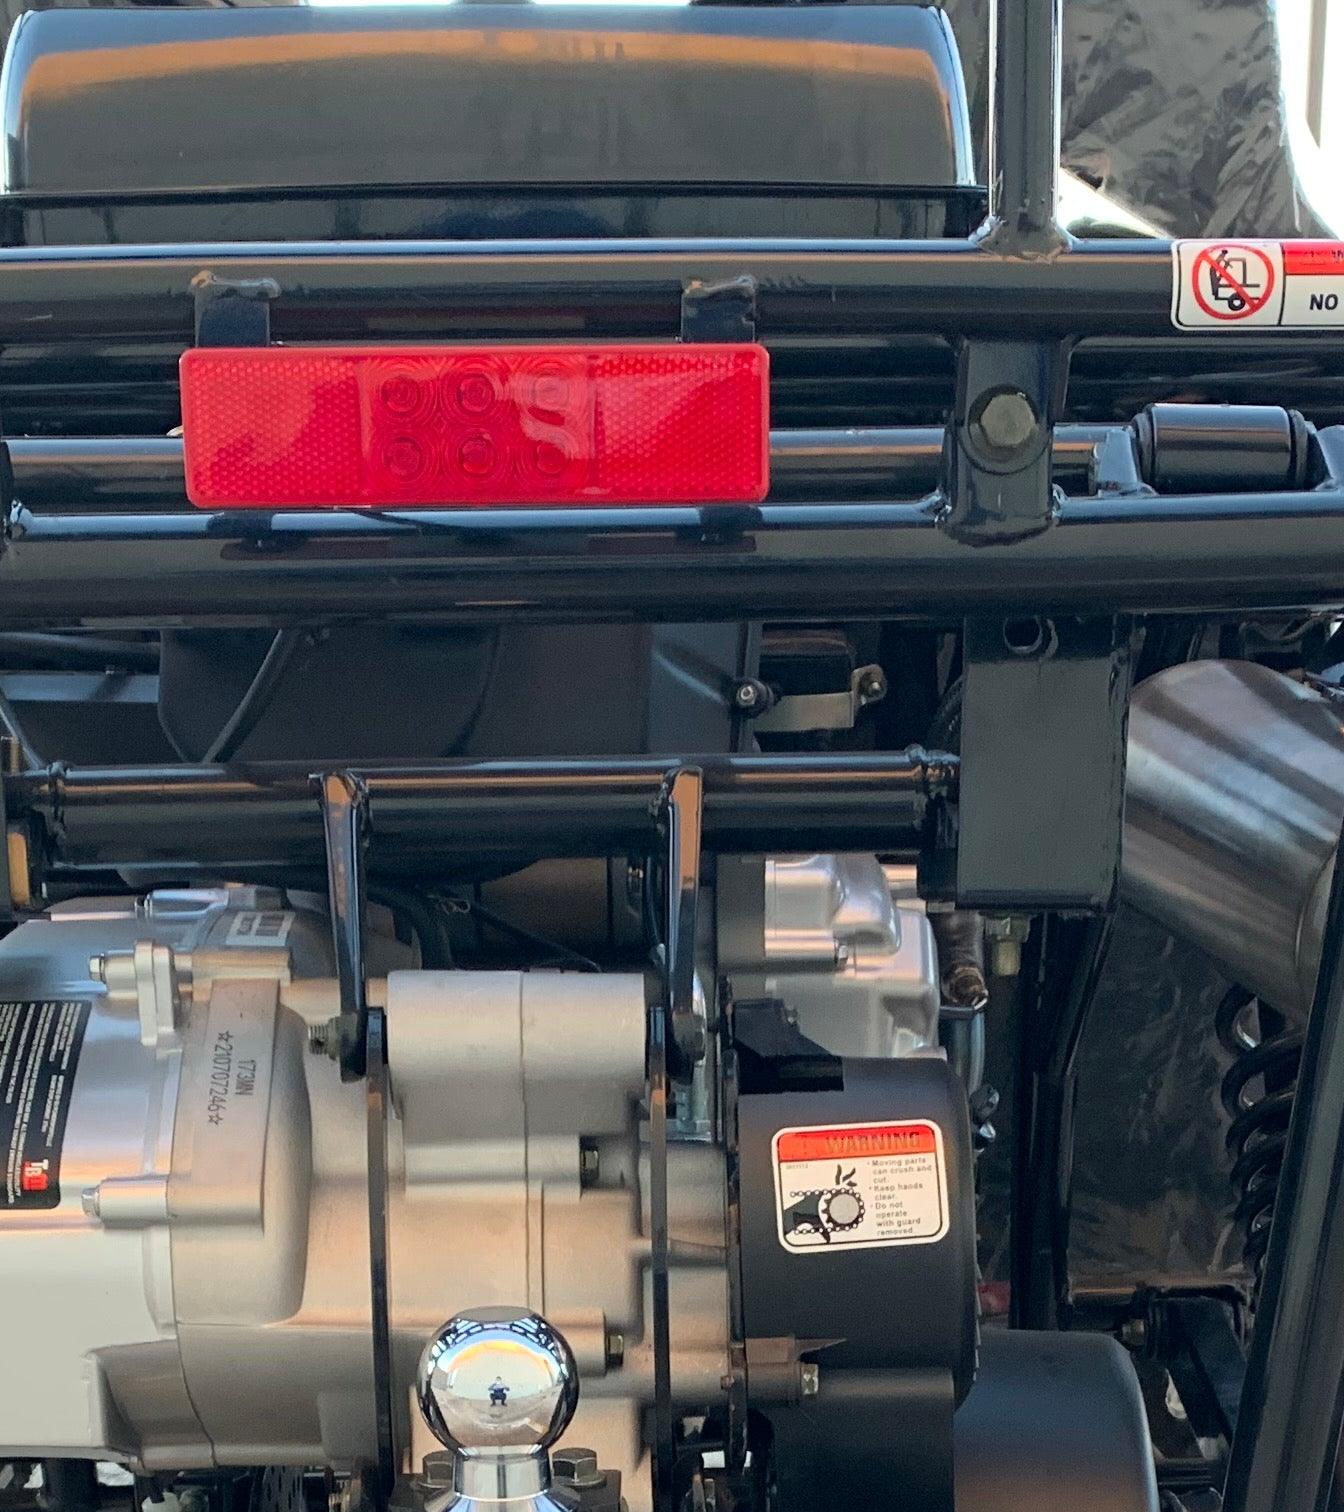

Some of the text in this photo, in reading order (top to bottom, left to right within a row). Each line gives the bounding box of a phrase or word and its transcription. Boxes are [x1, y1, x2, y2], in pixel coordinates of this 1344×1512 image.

[1309, 293, 1339, 311] NO
[825, 1131, 920, 1153] WARNING
[872, 1157, 926, 1167] Moving parts
[890, 1166, 914, 1174] crush
[875, 1202, 887, 1210] Do
[876, 1210, 907, 1219] operate
[897, 1218, 921, 1227] guard
